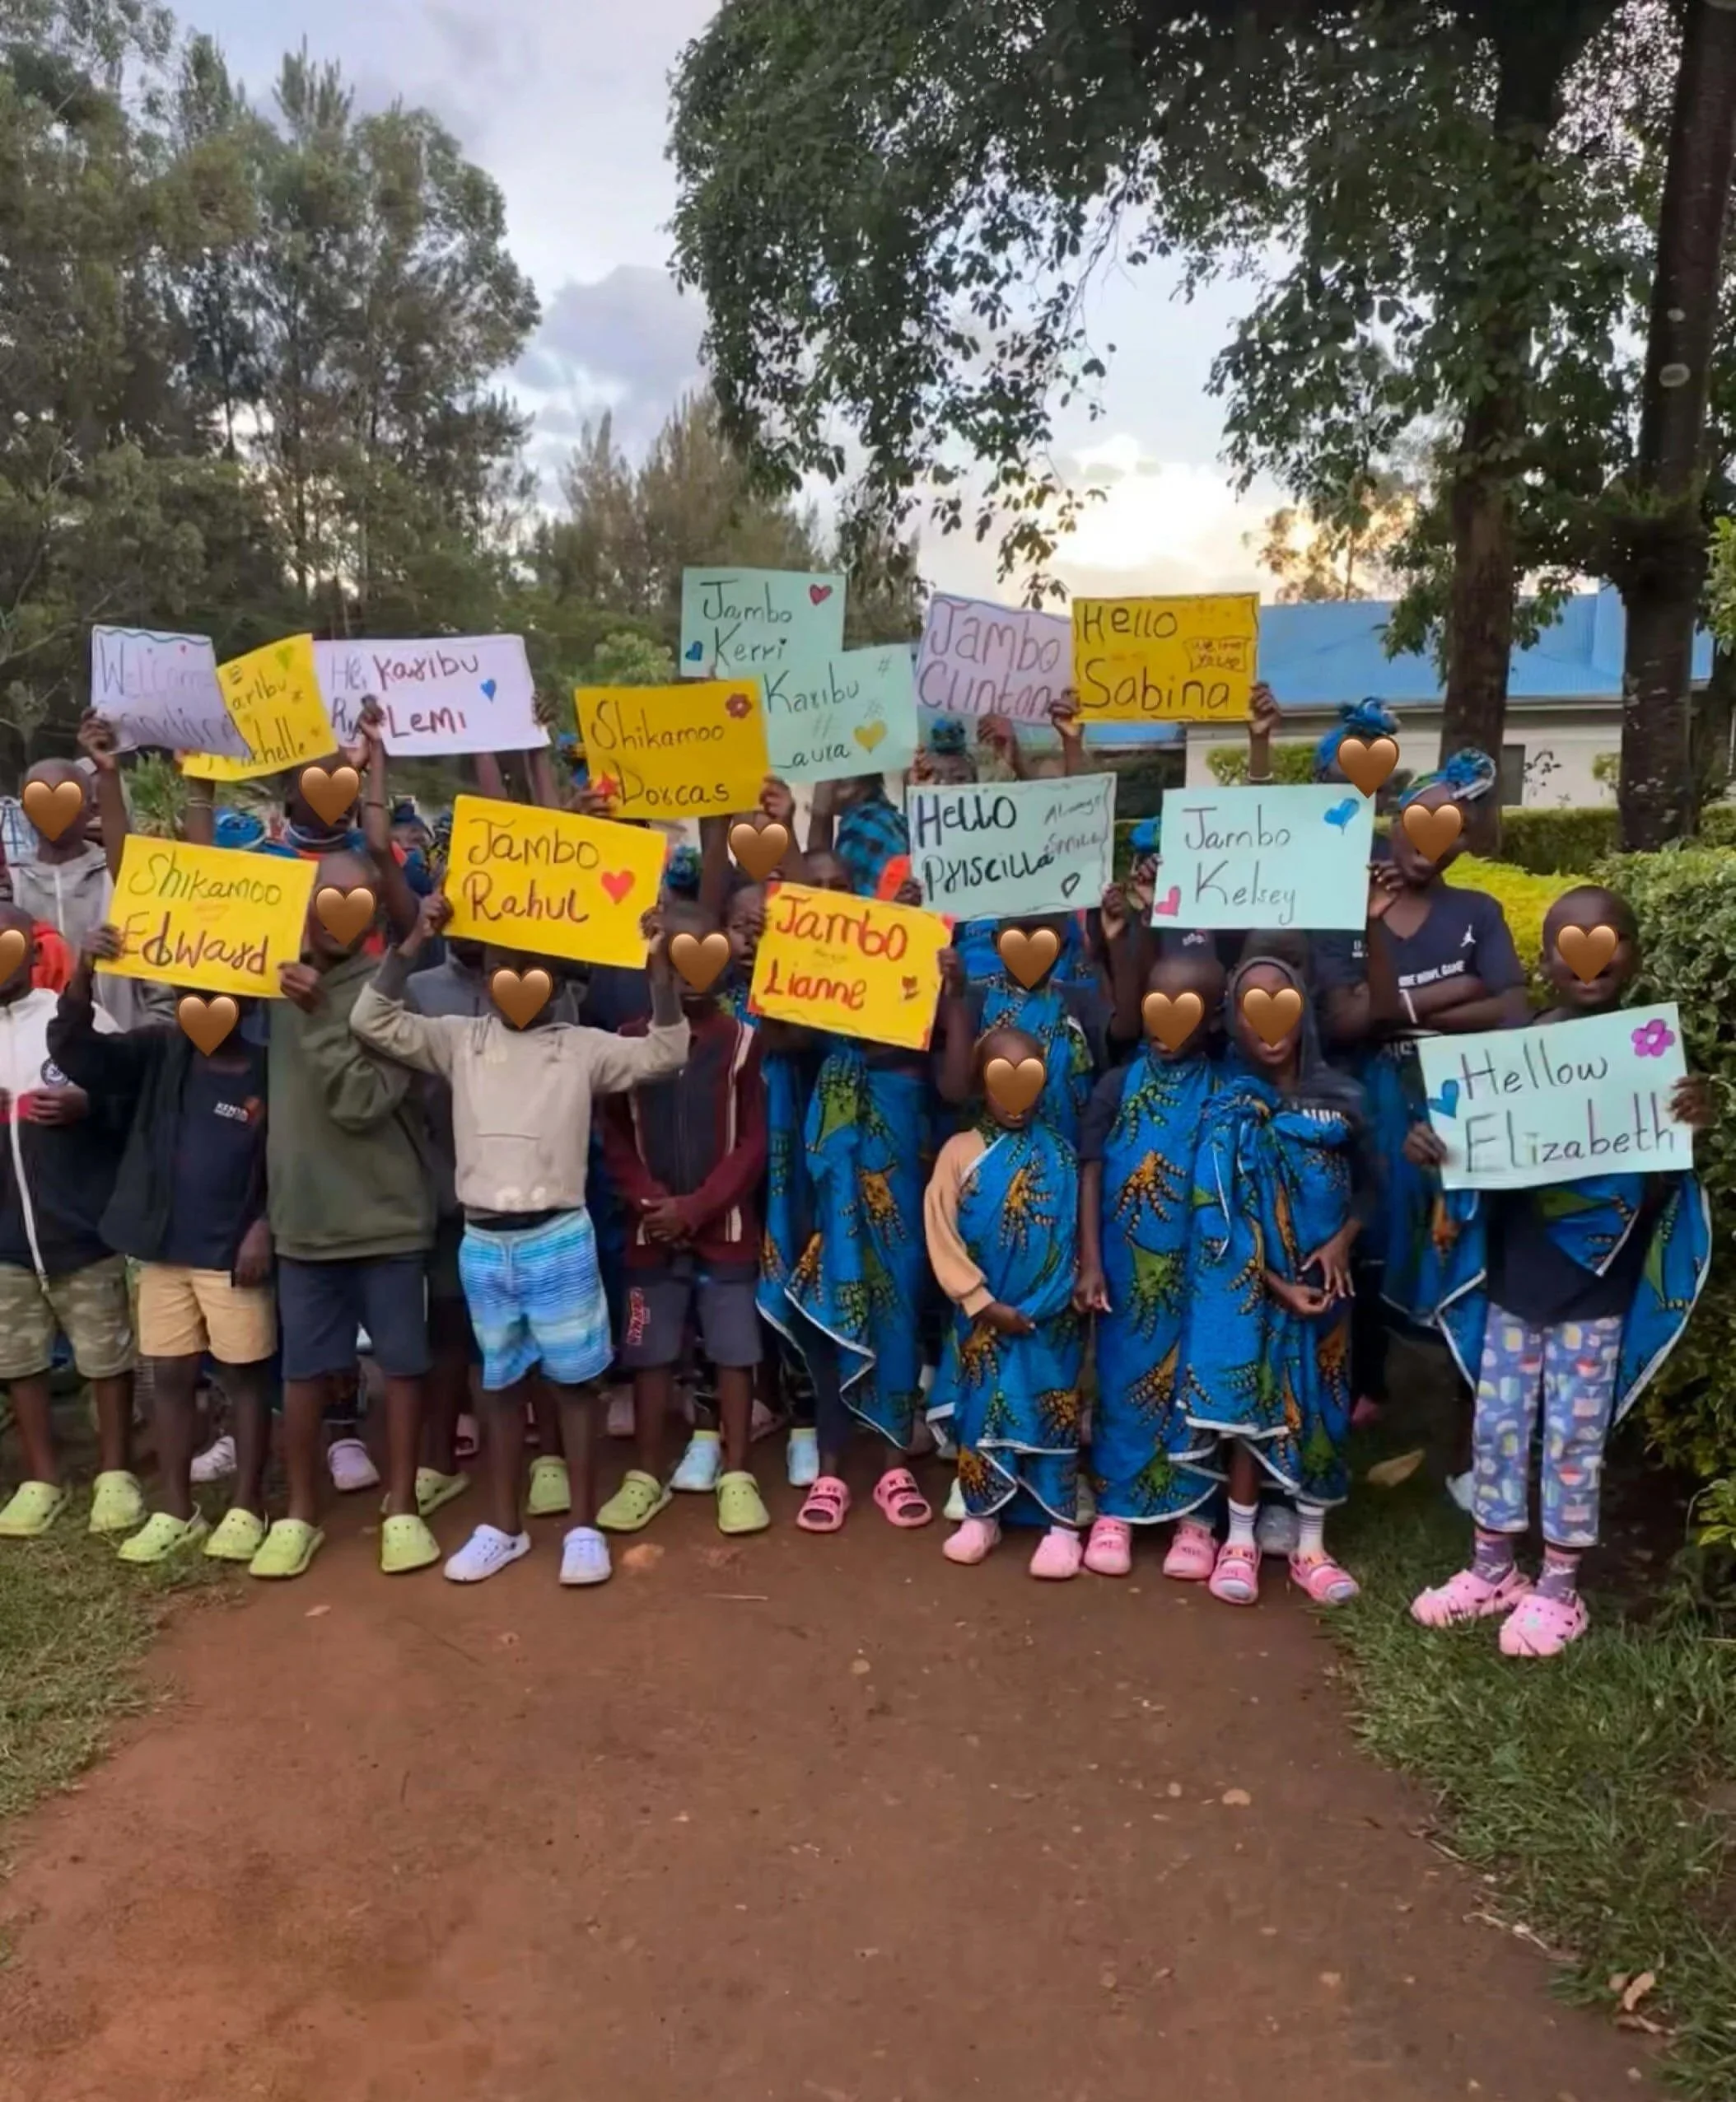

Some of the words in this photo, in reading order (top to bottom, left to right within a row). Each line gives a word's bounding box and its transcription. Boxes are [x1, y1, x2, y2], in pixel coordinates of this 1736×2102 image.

[700, 579, 792, 623] Jambo
[1082, 603, 1178, 645] Hello
[712, 623, 787, 667] Kerri
[931, 601, 1062, 674] Jambo
[763, 661, 860, 714] Karibu
[1082, 656, 1231, 712] Sabina
[590, 698, 726, 751] Shikamoo
[609, 759, 730, 806] Dorcas
[467, 817, 600, 870] Jambo
[1182, 803, 1292, 851] Jambo
[127, 849, 282, 907] Shikamoo
[461, 870, 590, 923] Rahul
[1194, 859, 1297, 927] Kelsey
[774, 894, 908, 962] Jambo
[763, 957, 868, 1011] Lianne
[1460, 1037, 1610, 1100] Hellow
[1464, 1091, 1676, 1174] Elizabeth
